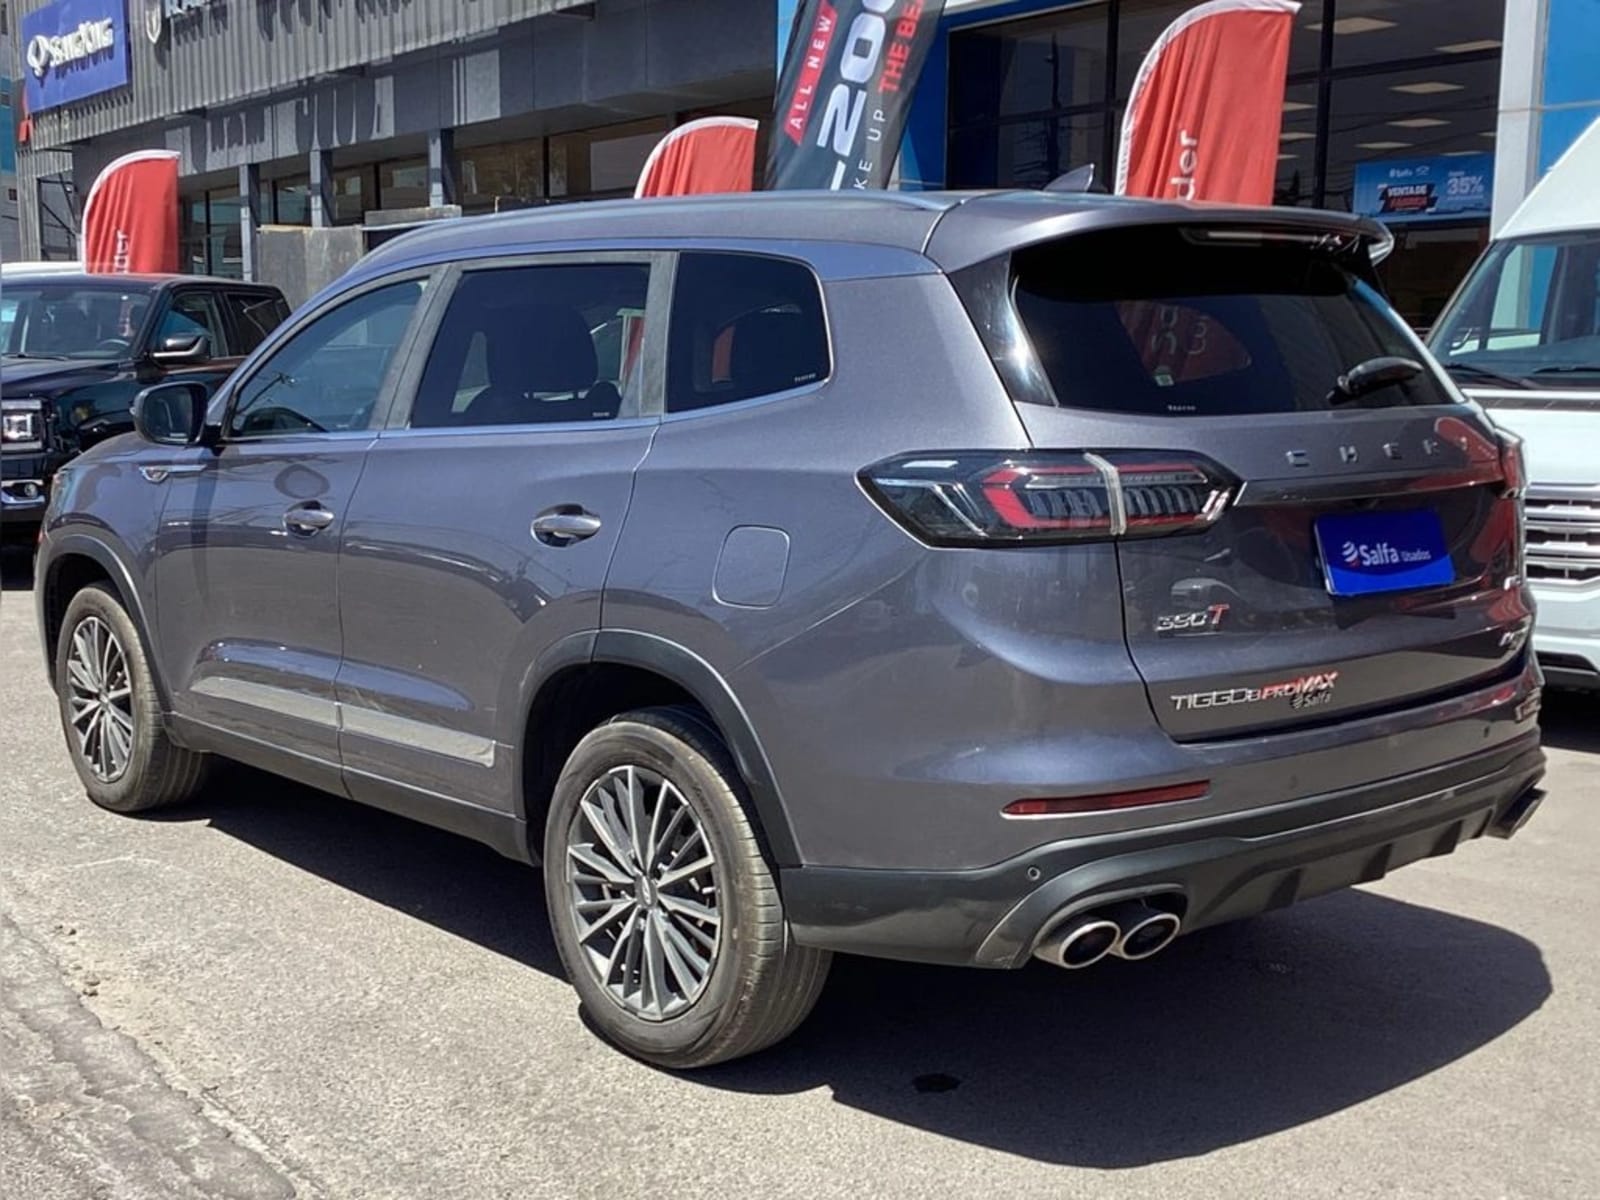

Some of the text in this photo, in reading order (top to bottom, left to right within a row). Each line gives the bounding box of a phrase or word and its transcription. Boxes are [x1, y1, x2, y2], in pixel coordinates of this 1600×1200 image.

[790, 16, 832, 129] ALL NEW
[866, 109, 887, 142] UP
[878, 43, 911, 92] THE
[1359, 542, 1431, 566] Salfa Usados
